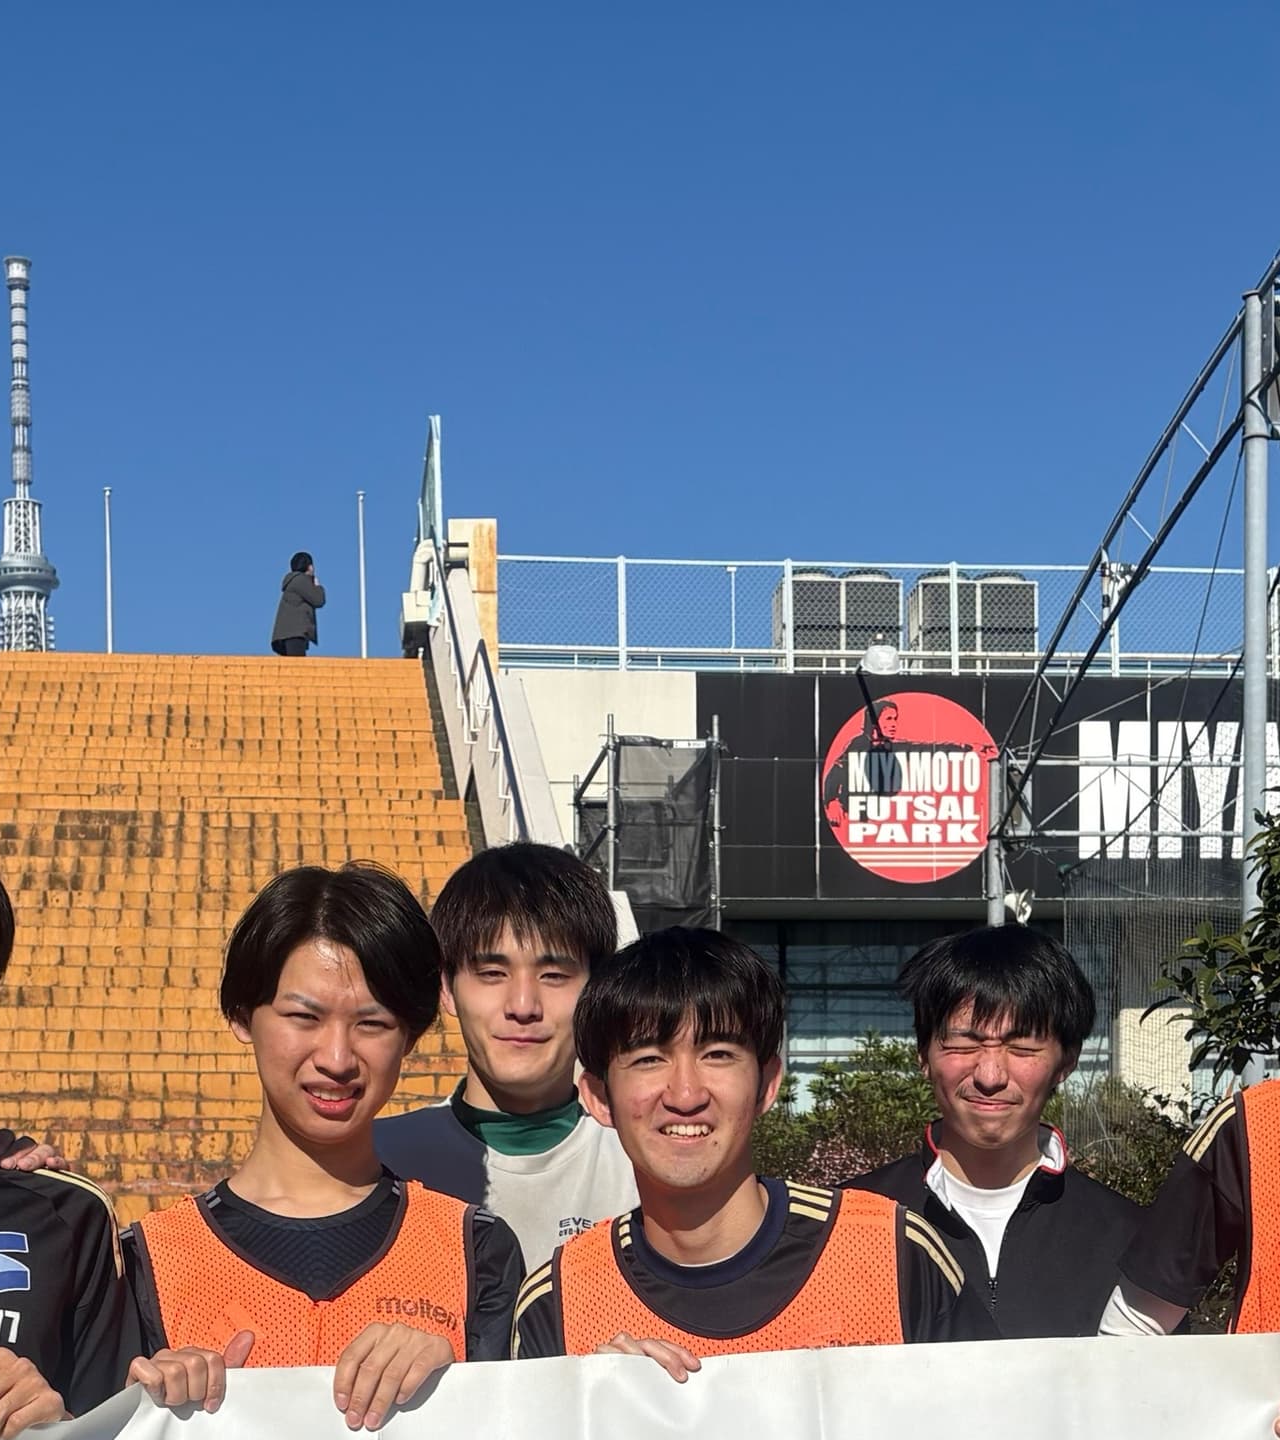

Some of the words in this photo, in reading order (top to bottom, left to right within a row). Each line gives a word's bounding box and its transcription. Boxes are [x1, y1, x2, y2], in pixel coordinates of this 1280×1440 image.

[847, 751, 981, 794] MIYAMOTO
[847, 795, 981, 822] FUTSAL
[848, 823, 980, 844] PARK
[375, 1295, 458, 1331] molten
